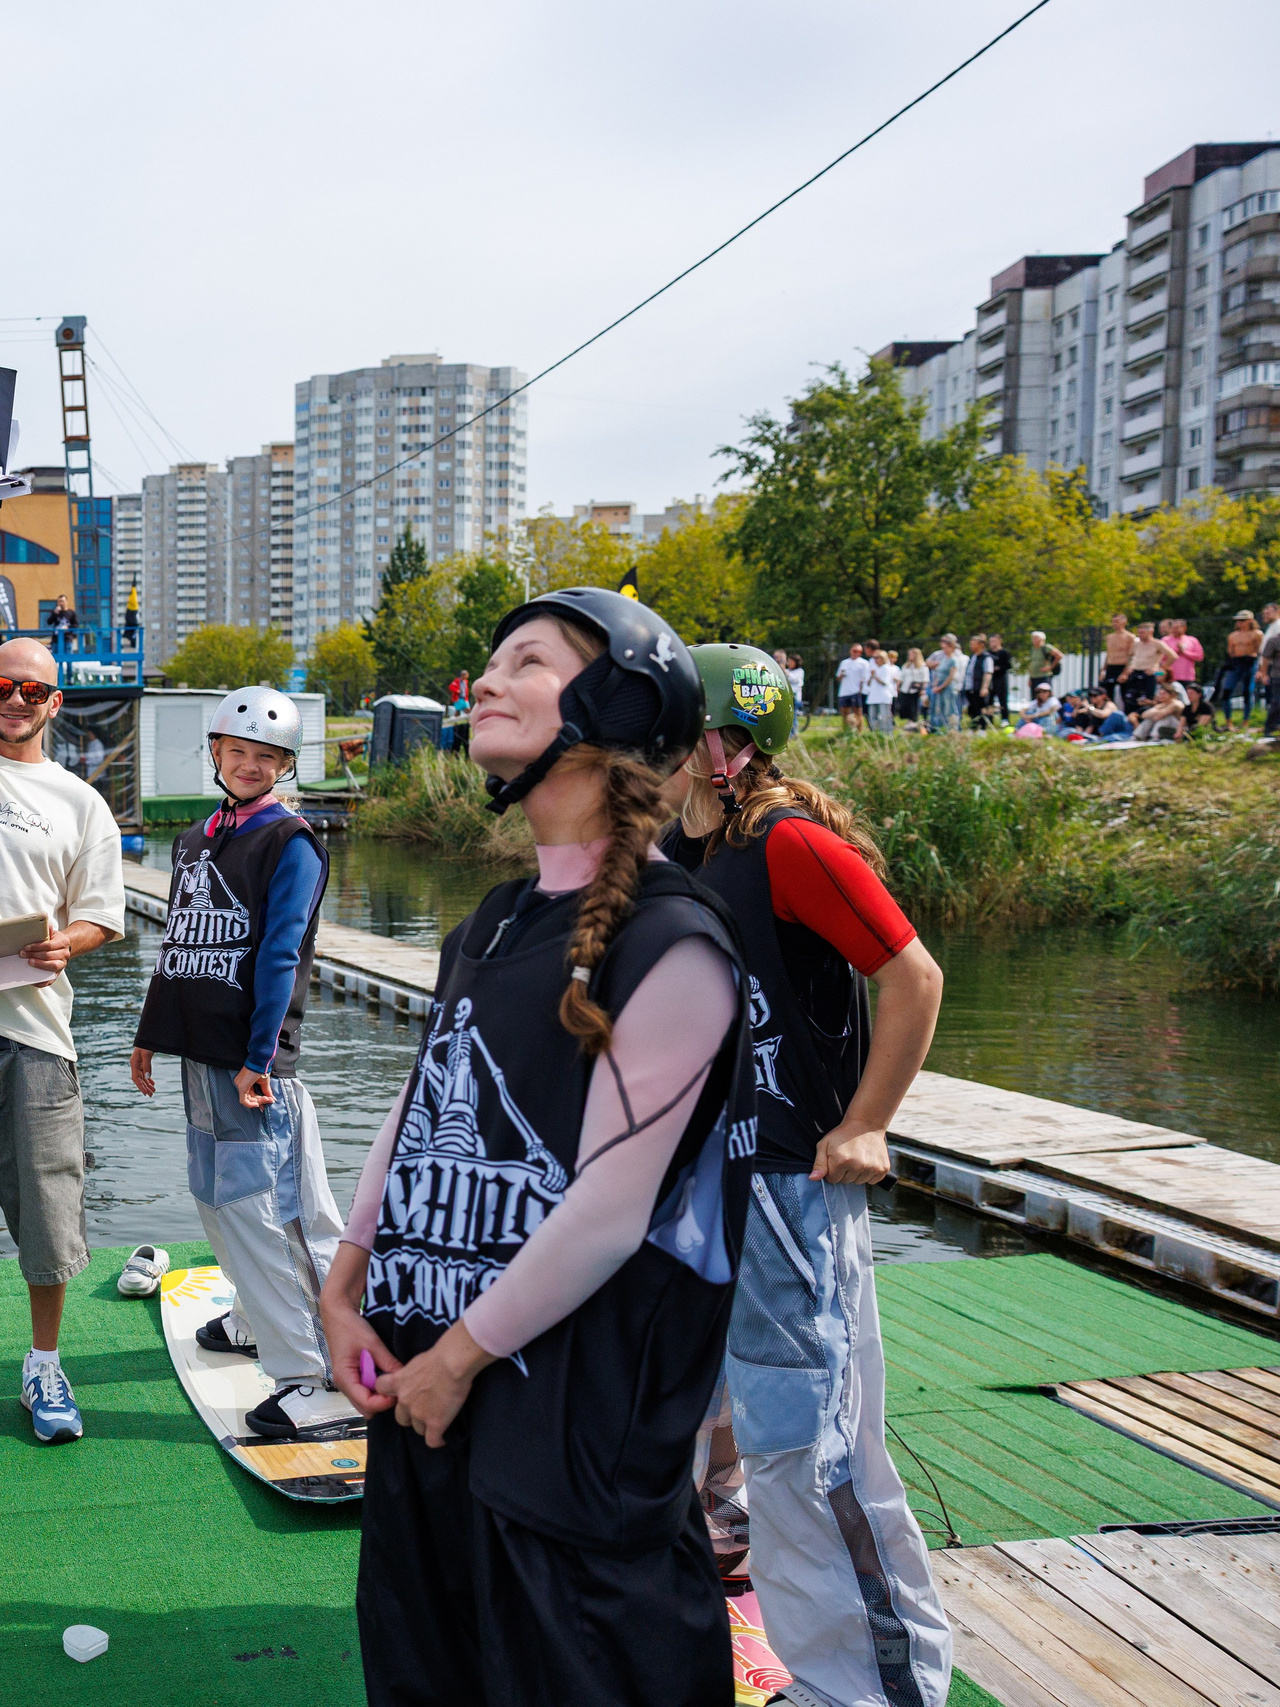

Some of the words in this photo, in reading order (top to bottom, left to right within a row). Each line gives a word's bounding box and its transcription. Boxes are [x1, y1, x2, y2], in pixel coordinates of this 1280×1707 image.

[732, 667, 785, 690] PIRATE
[741, 684, 767, 698] BAY
[163, 947, 247, 987] CONTEST
